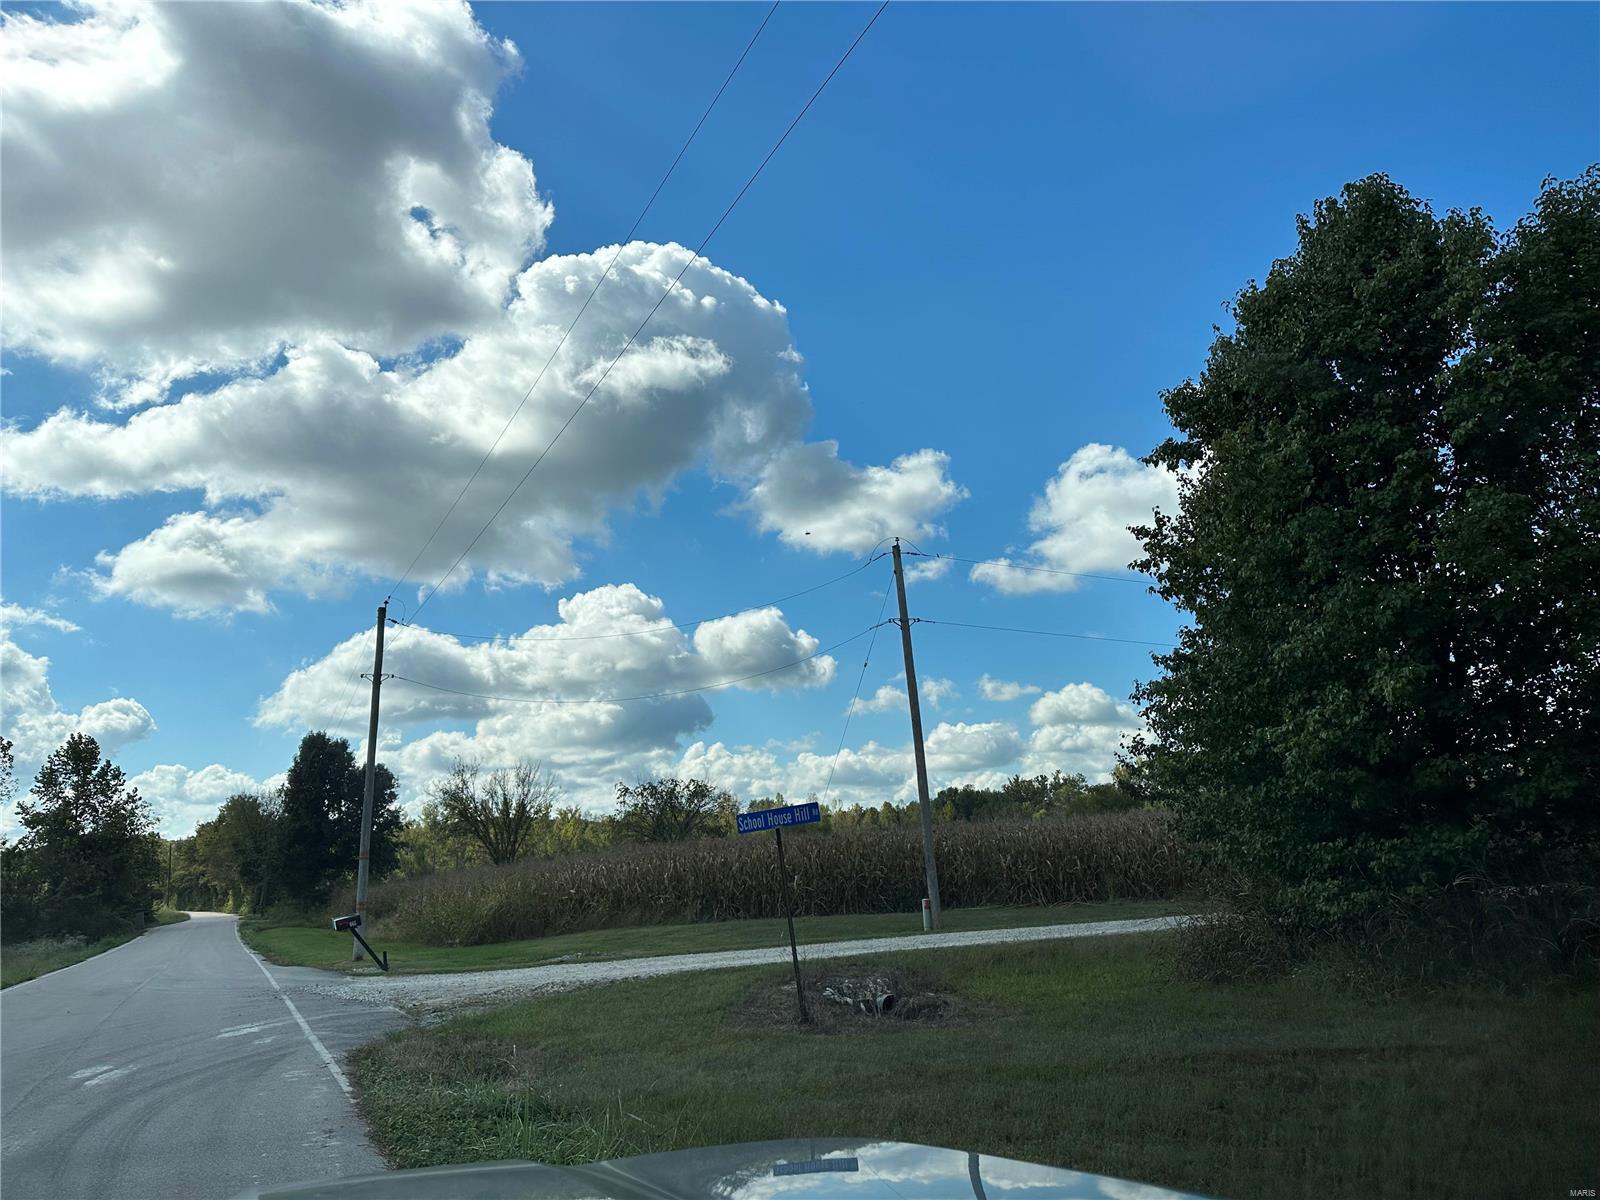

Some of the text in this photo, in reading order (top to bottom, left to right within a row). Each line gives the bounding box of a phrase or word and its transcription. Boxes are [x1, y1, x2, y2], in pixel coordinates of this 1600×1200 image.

[738, 815, 765, 831] School
[767, 812, 792, 826] House
[794, 806, 810, 822] Hill
